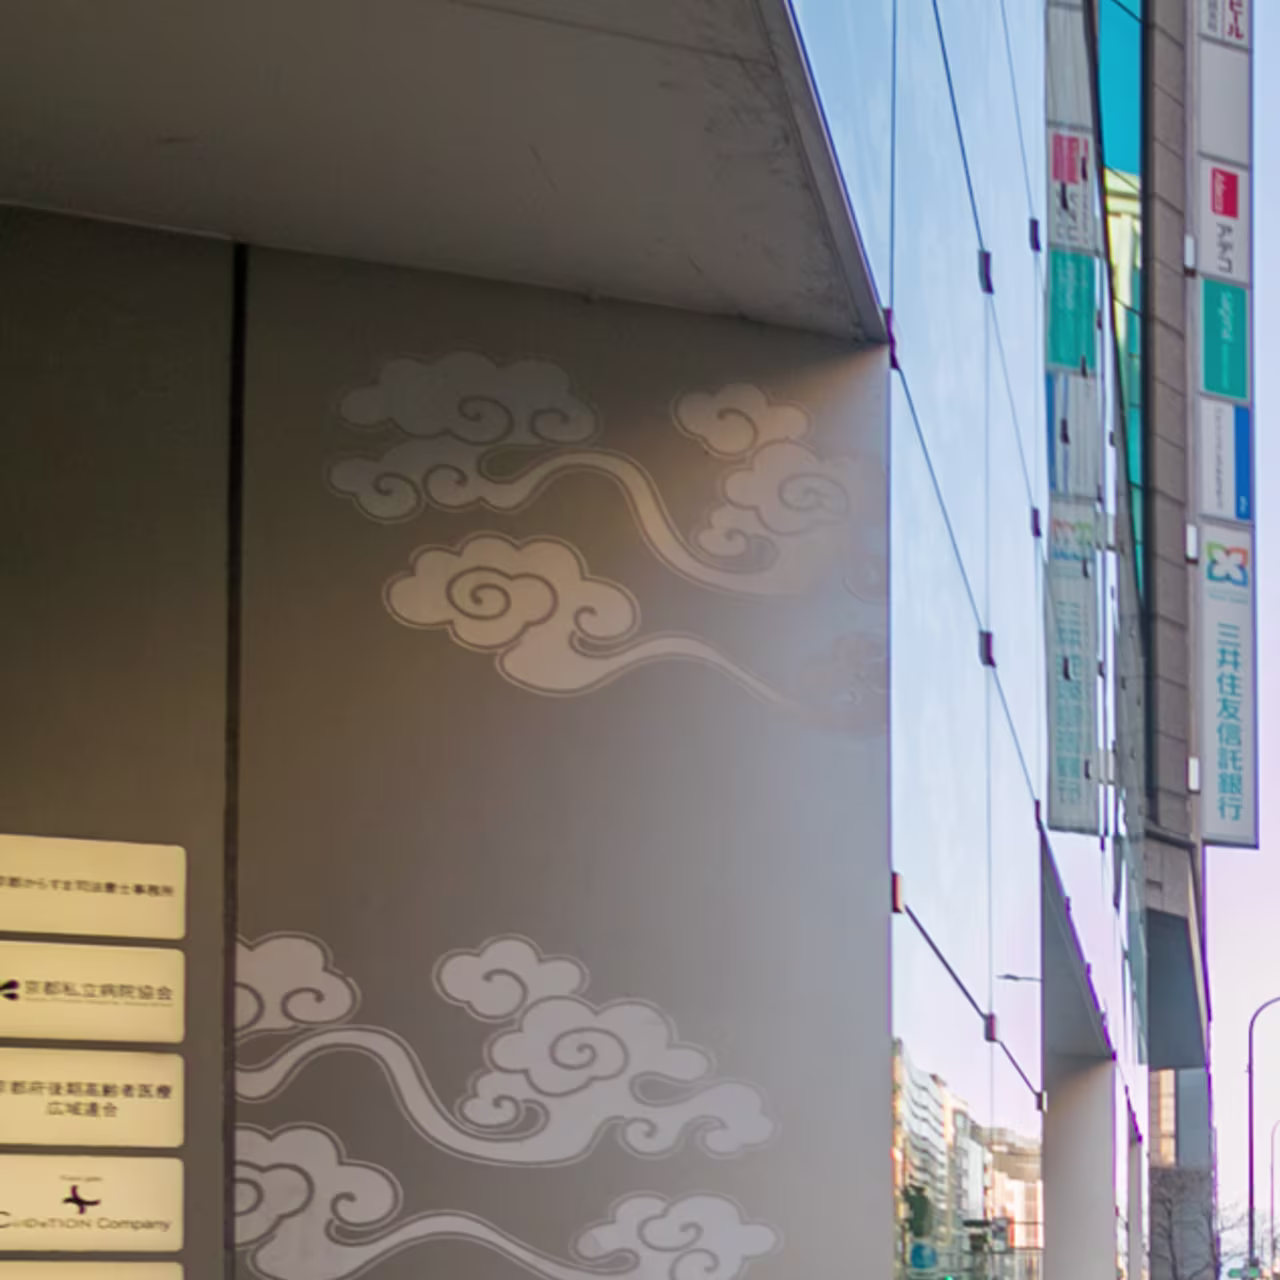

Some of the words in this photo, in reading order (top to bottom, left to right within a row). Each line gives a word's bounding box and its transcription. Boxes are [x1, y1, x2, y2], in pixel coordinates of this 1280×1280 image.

[1216, 622, 1243, 822] 三井住友信託銀行
[97, 1217, 172, 1232] Company
